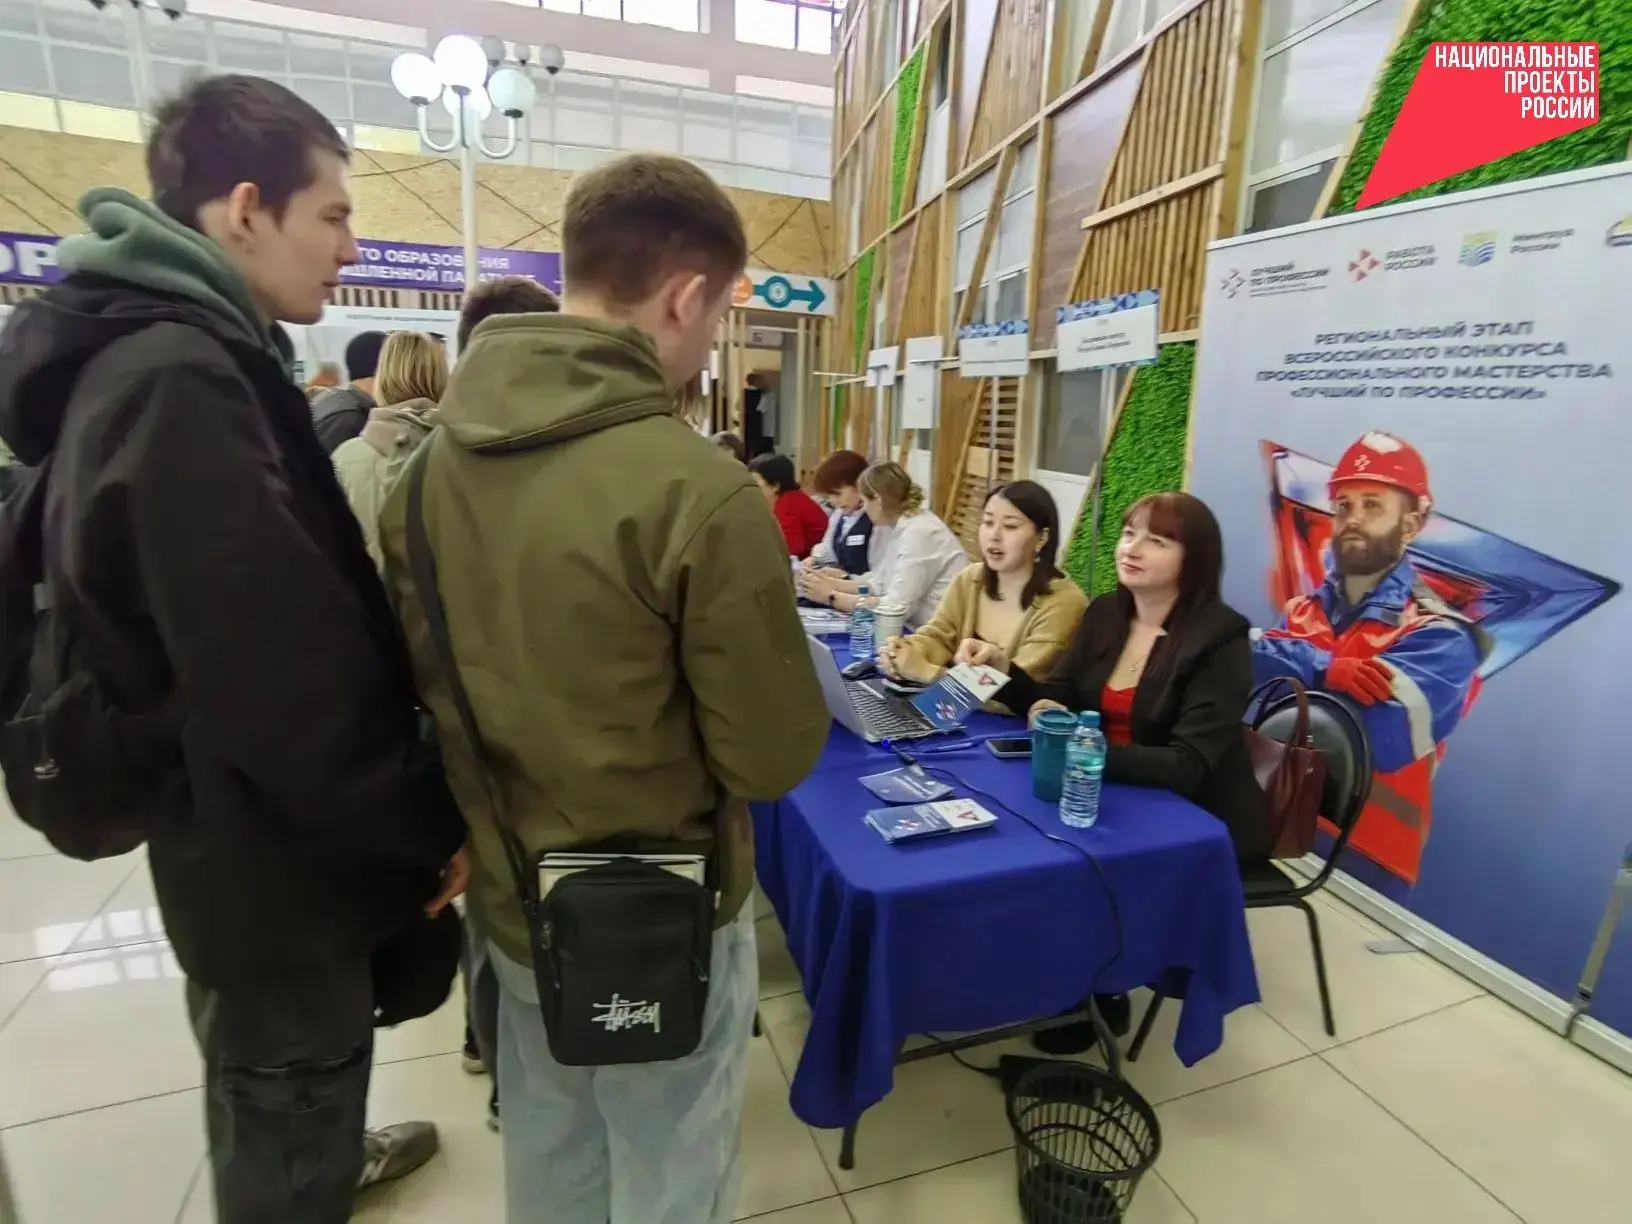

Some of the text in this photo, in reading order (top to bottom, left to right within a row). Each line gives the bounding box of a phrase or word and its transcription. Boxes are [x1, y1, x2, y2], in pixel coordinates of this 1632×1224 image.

[1315, 321, 1535, 345] РЕГИОНАЛЬНЫЙ ЭТАП
[1284, 341, 1567, 365] ВСЕРОССИЙСКОГО КОНКУРСА
[1256, 363, 1613, 381] ПРОФЕССИОНАЛЬНОГО МАСТЕРСТВА
[1291, 384, 1547, 400] «ЛУЧШИЙ ПО ПРОФЕССИИ»
